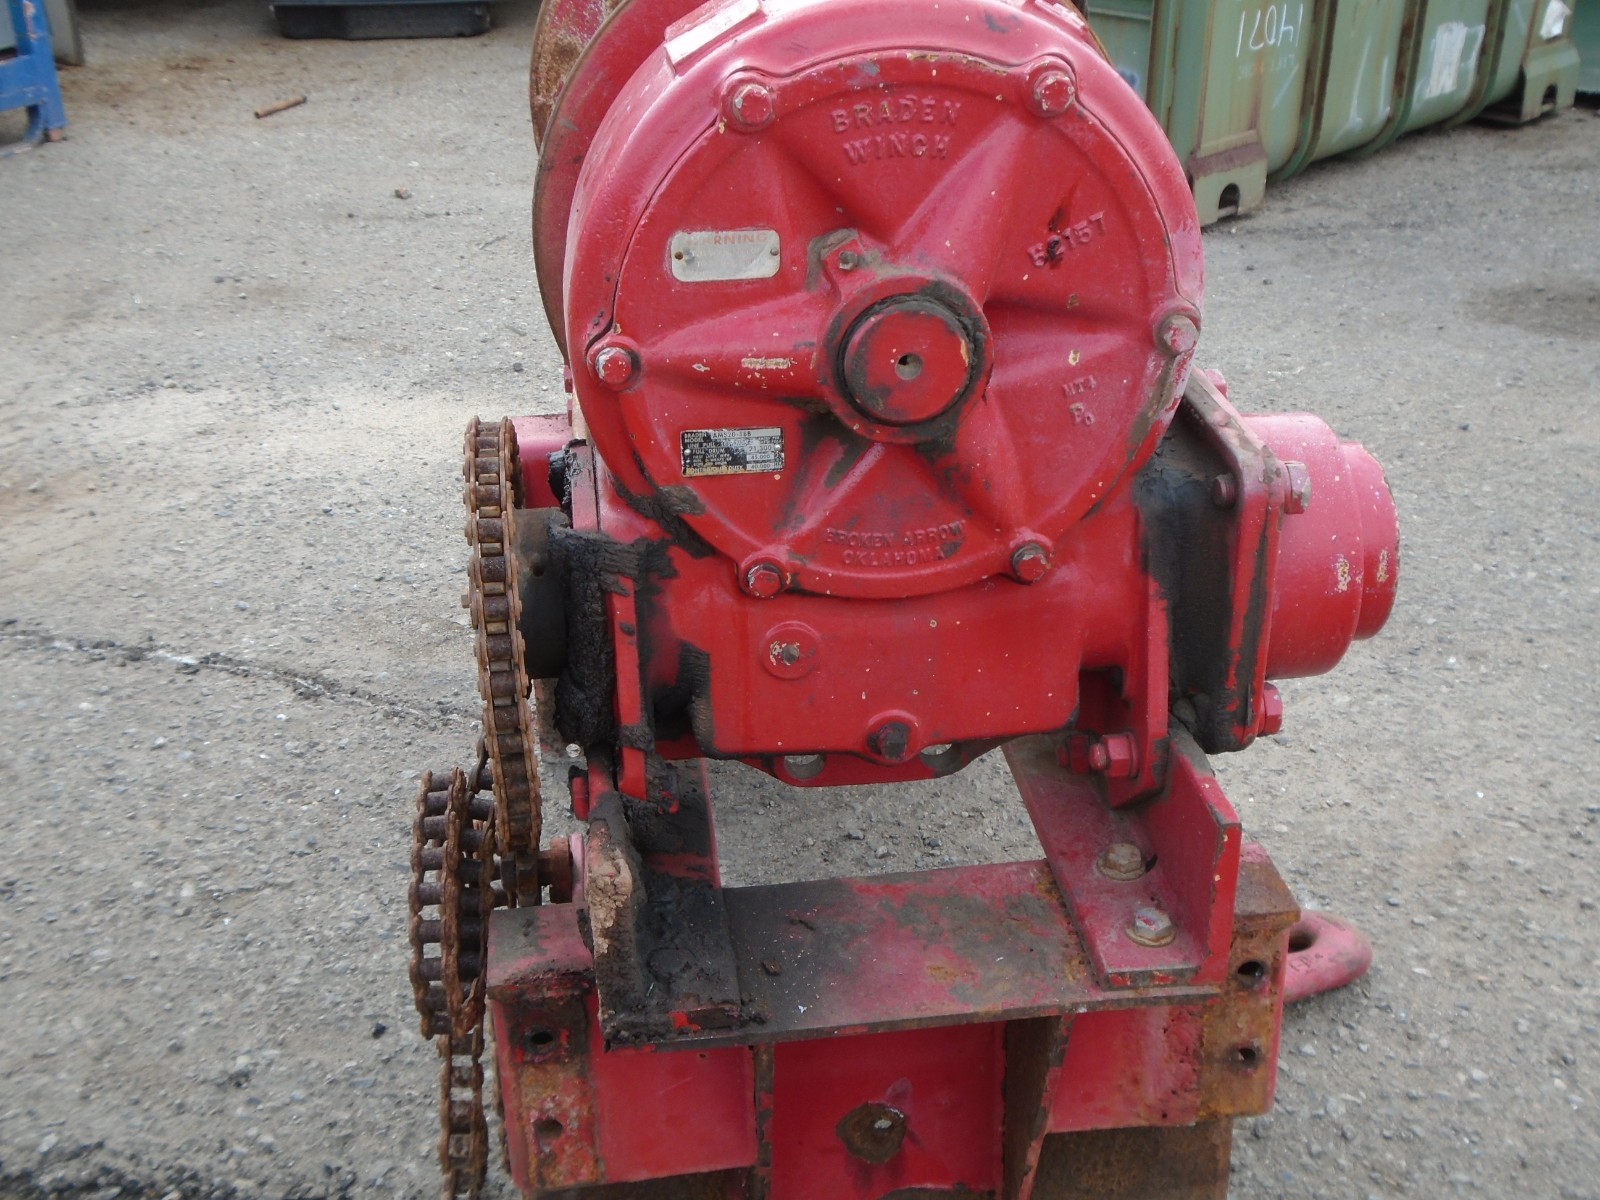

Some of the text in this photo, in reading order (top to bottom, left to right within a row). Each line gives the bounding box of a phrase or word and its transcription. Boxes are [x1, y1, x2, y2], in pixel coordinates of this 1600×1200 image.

[831, 97, 961, 133] BRADEN
[843, 133, 950, 165] WINCH
[826, 527, 895, 547] BROKEN
